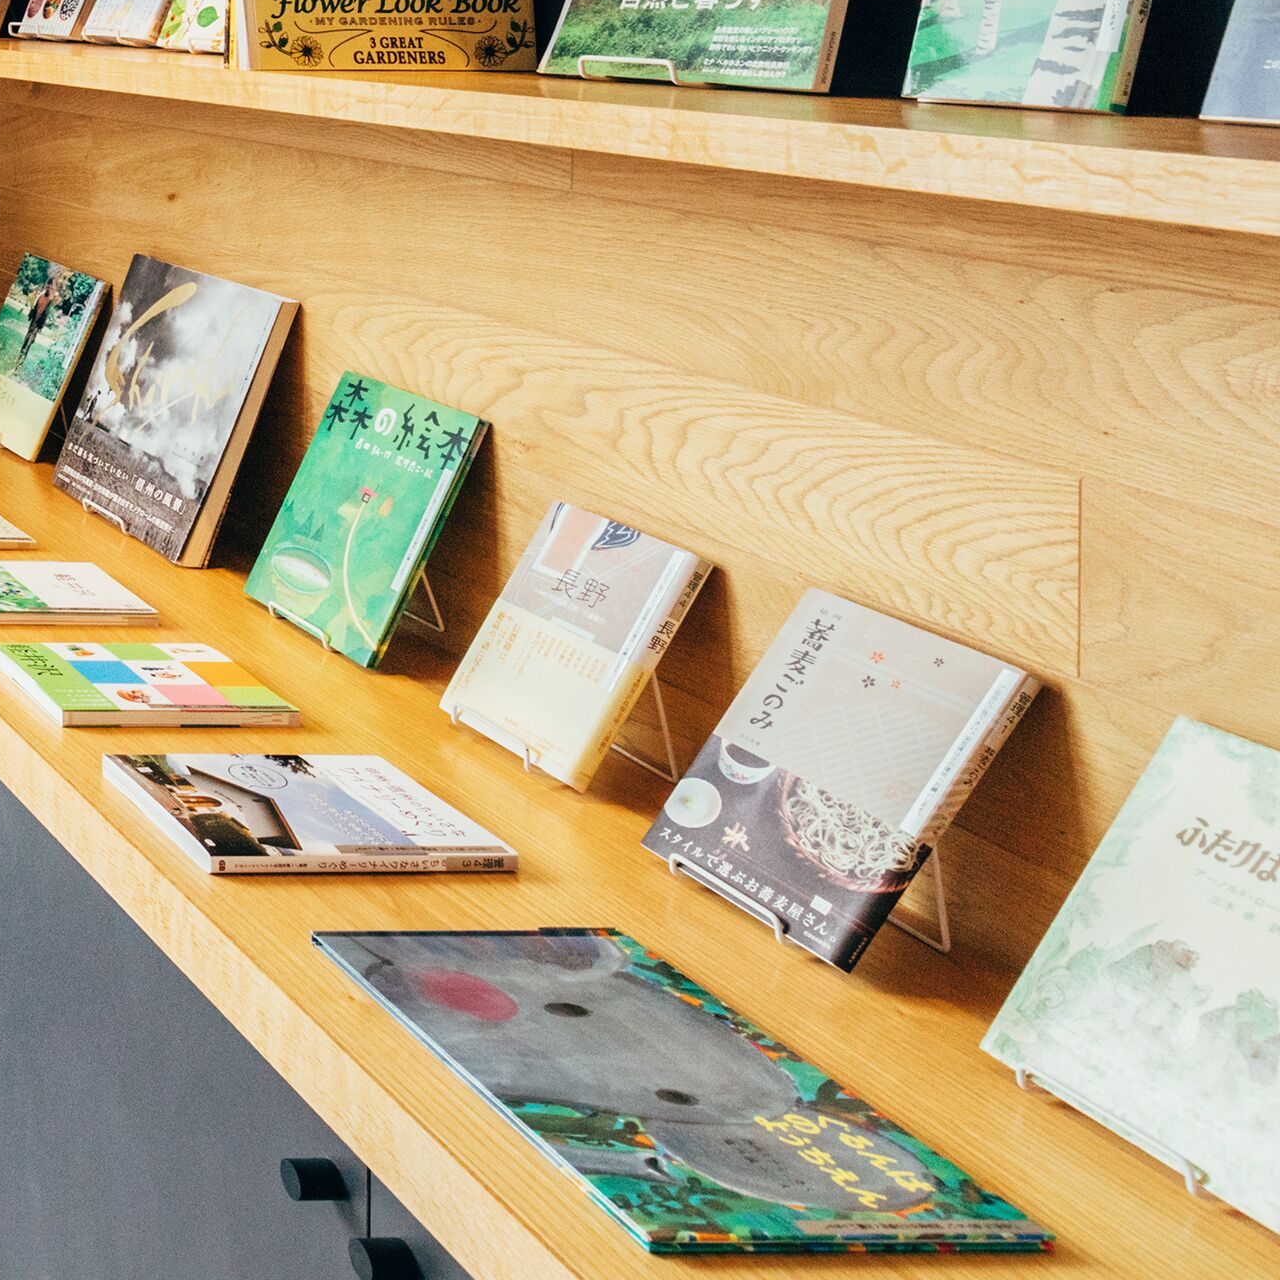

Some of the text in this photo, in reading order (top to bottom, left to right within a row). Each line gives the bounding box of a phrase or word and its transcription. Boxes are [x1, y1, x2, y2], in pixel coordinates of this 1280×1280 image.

[315, 17, 475, 26] MY GARDENING RULES
[353, 51, 446, 65] GARDENERS
[370, 37, 424, 48] 3 GREAT
[326, 379, 468, 470] 森の絵本
[551, 568, 610, 608] 長野
[647, 620, 676, 655] 長野
[5, 644, 64, 676] 軽井沢
[750, 618, 837, 730] 蕎麦ごのみ
[342, 767, 448, 837] ワイナリーめぐり
[1176, 816, 1280, 883] ふたりは
[659, 826, 837, 944] スタイルで選ぶお蕎麦屋さん。
[783, 1113, 821, 1135] の
[753, 1115, 887, 1210] ようちえん
